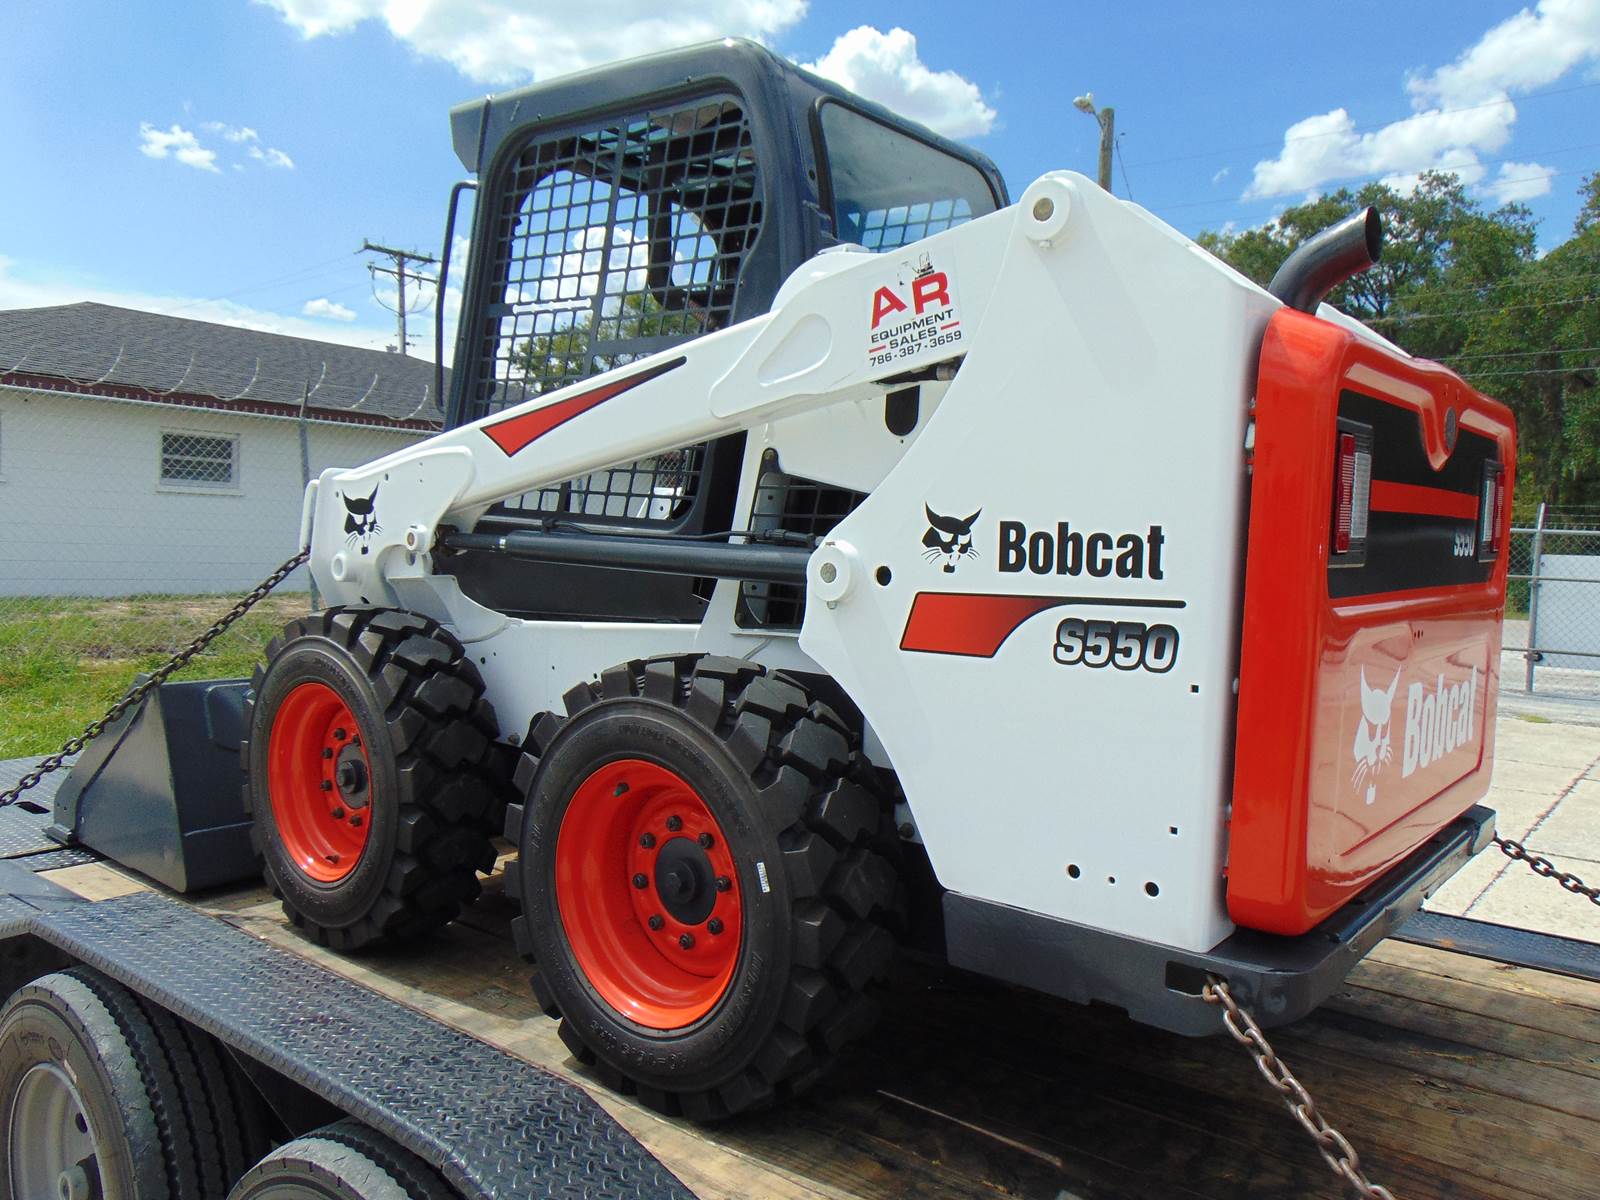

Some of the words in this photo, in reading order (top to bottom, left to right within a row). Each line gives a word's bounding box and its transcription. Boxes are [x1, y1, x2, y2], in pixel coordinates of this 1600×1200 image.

[871, 308, 954, 343] EQUIPMENT
[889, 326, 938, 350] SALES
[999, 520, 1165, 580] Bobcat
[1053, 617, 1180, 674] S550
[1401, 665, 1477, 779] Bobcat
